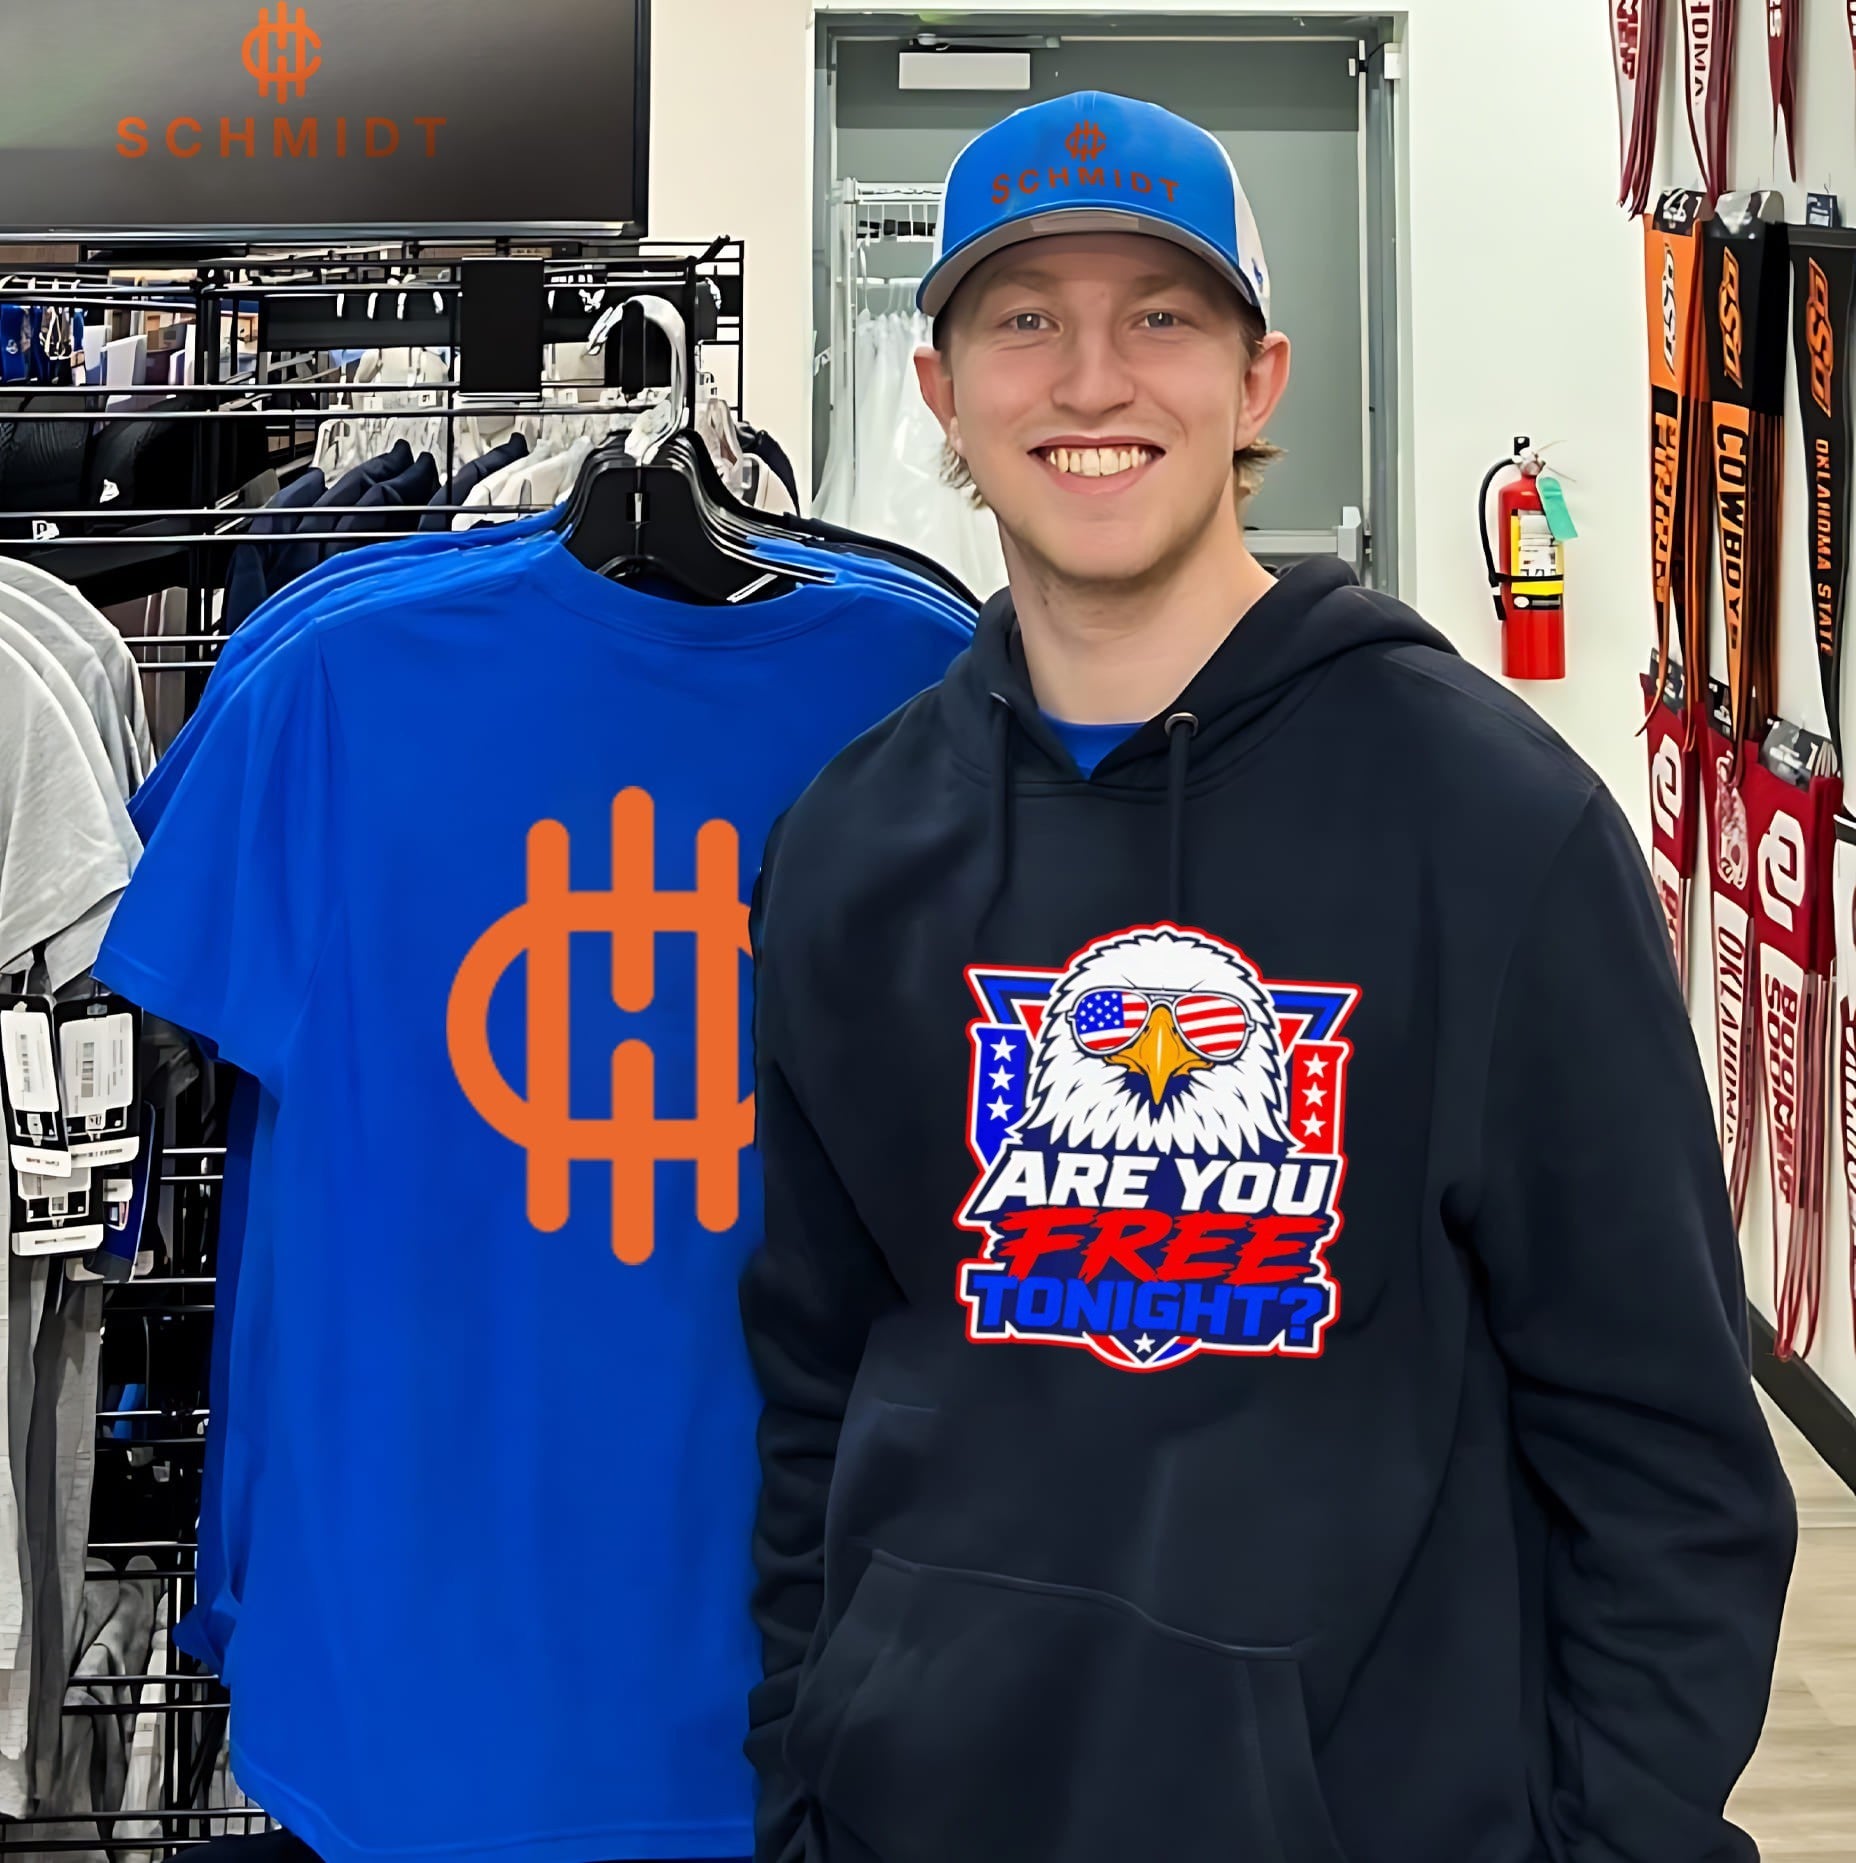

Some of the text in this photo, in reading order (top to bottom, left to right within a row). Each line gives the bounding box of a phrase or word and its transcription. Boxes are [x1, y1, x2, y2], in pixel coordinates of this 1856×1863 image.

[116, 116, 447, 159] SCHMIDT
[991, 166, 1179, 205] SCHMIDT
[1815, 438, 1832, 571] OKLAHOMA
[1718, 926, 1745, 1144] OKLAHOMA
[975, 1151, 1331, 1216] ARE YOU
[996, 1206, 1329, 1286] FREE
[973, 1275, 1323, 1340] TONIGHT?
